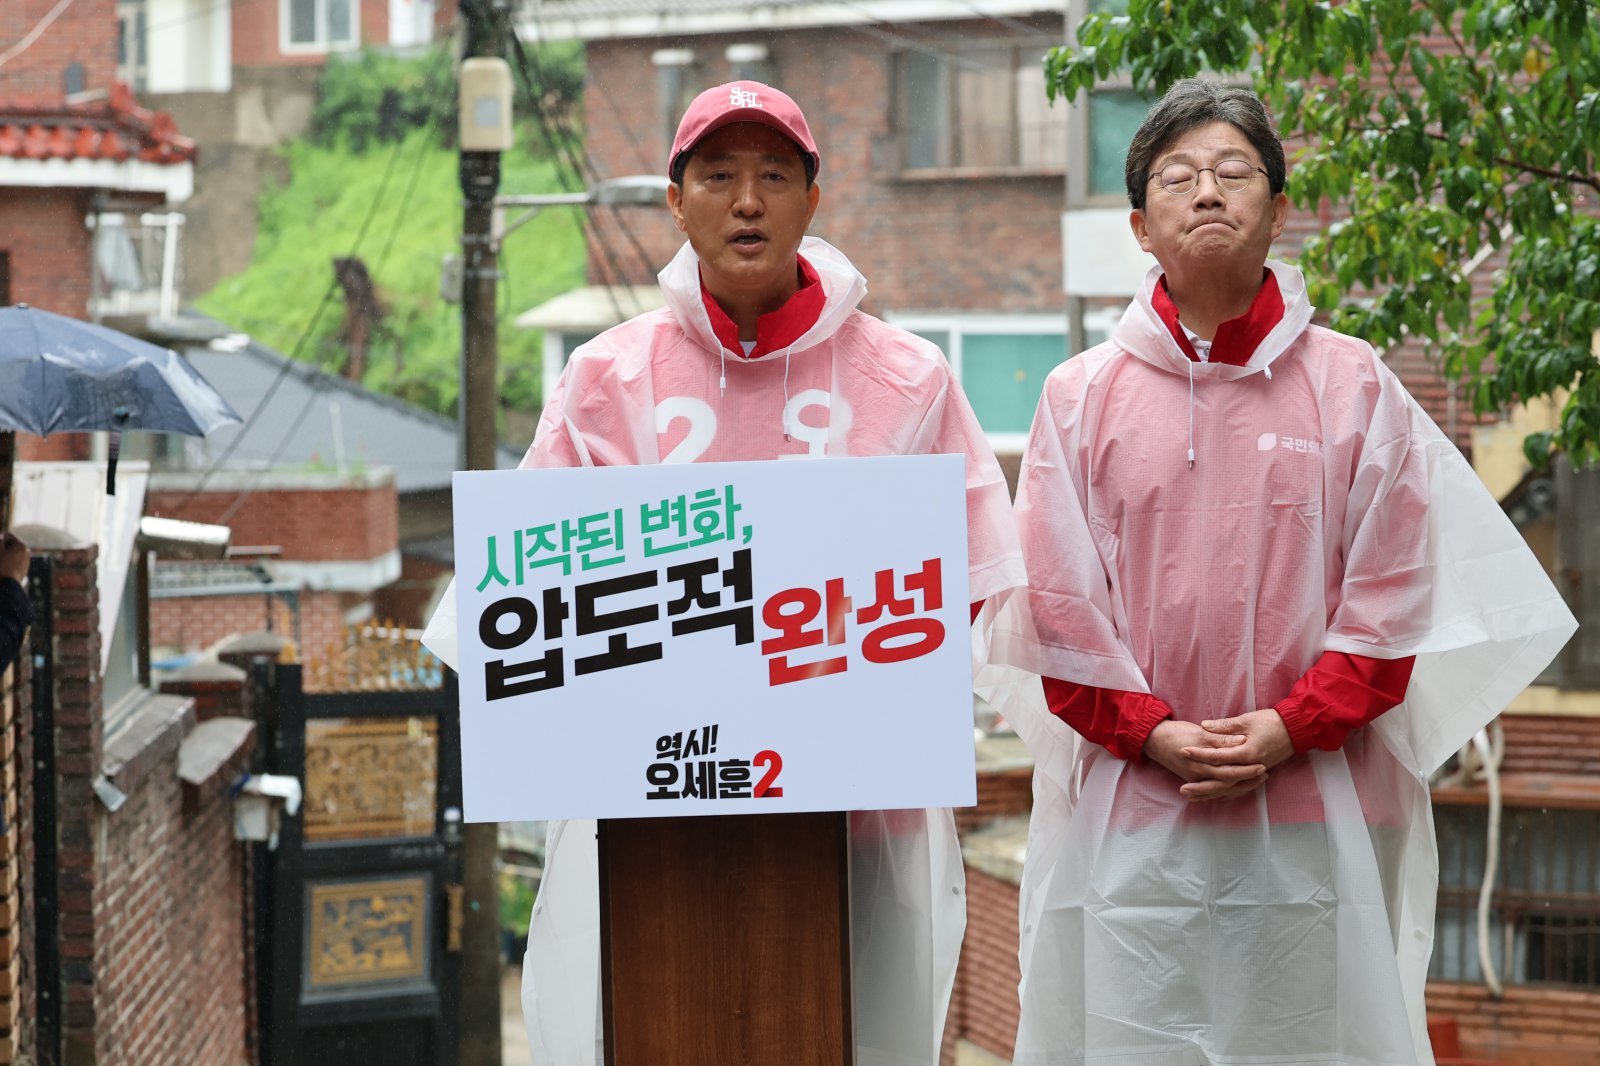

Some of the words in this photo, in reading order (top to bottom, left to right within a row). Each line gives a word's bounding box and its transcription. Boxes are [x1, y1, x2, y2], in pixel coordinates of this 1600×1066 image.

[654, 396, 718, 464] 2
[475, 508, 626, 593] 시작된
[640, 484, 753, 558] 변화,
[478, 548, 755, 702] 압도적
[761, 557, 946, 687] 완성
[655, 724, 719, 762] 역시!
